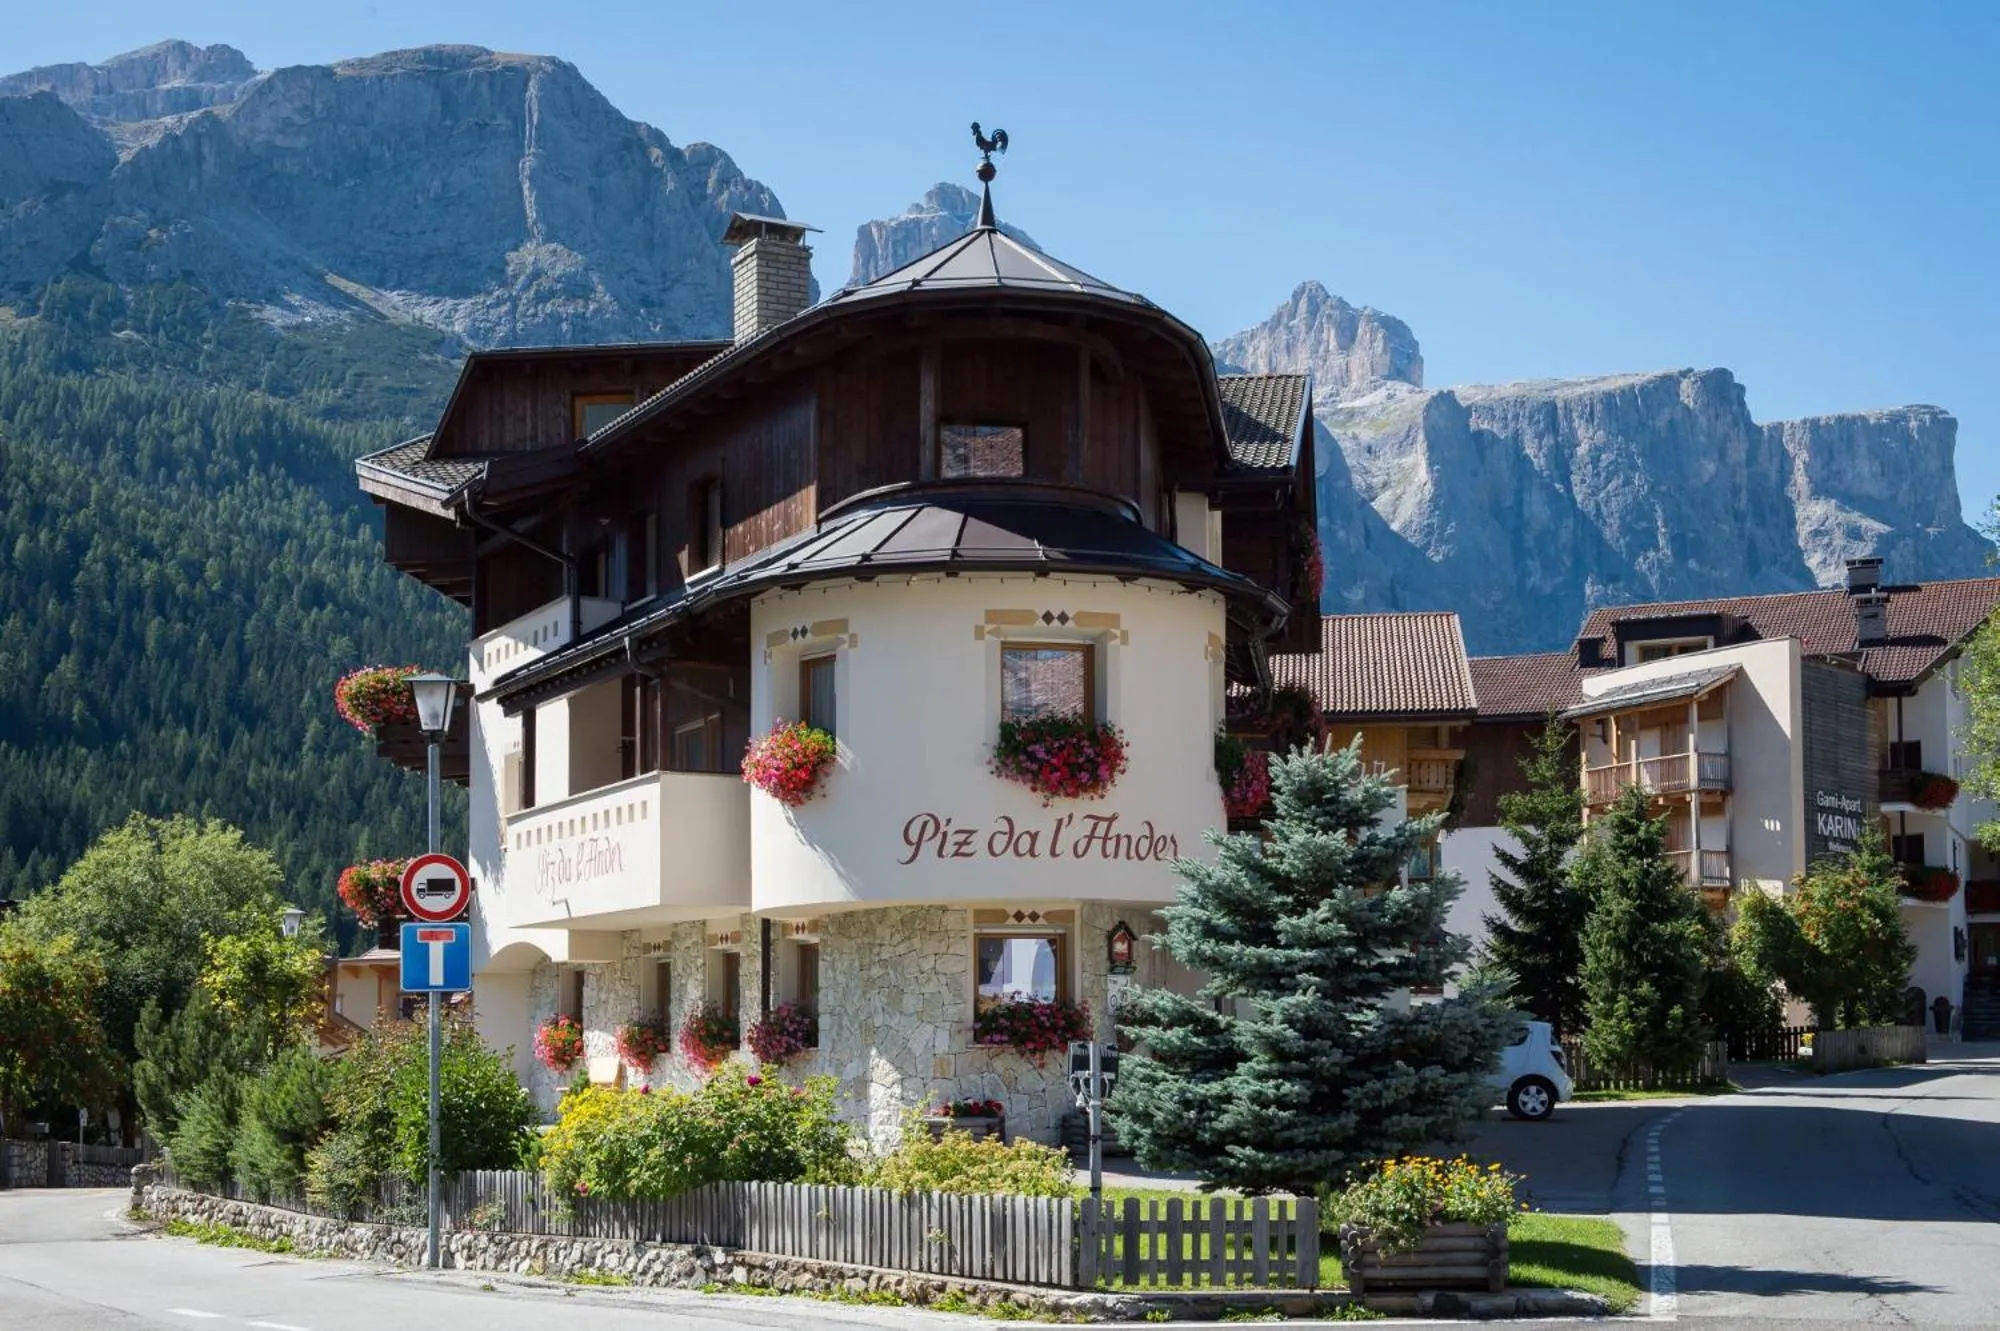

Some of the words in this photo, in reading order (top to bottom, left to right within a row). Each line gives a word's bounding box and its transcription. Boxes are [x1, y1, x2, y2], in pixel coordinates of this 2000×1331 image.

[898, 812, 979, 866] Piz
[987, 815, 1041, 858] da
[1817, 812, 1857, 840] KARIN
